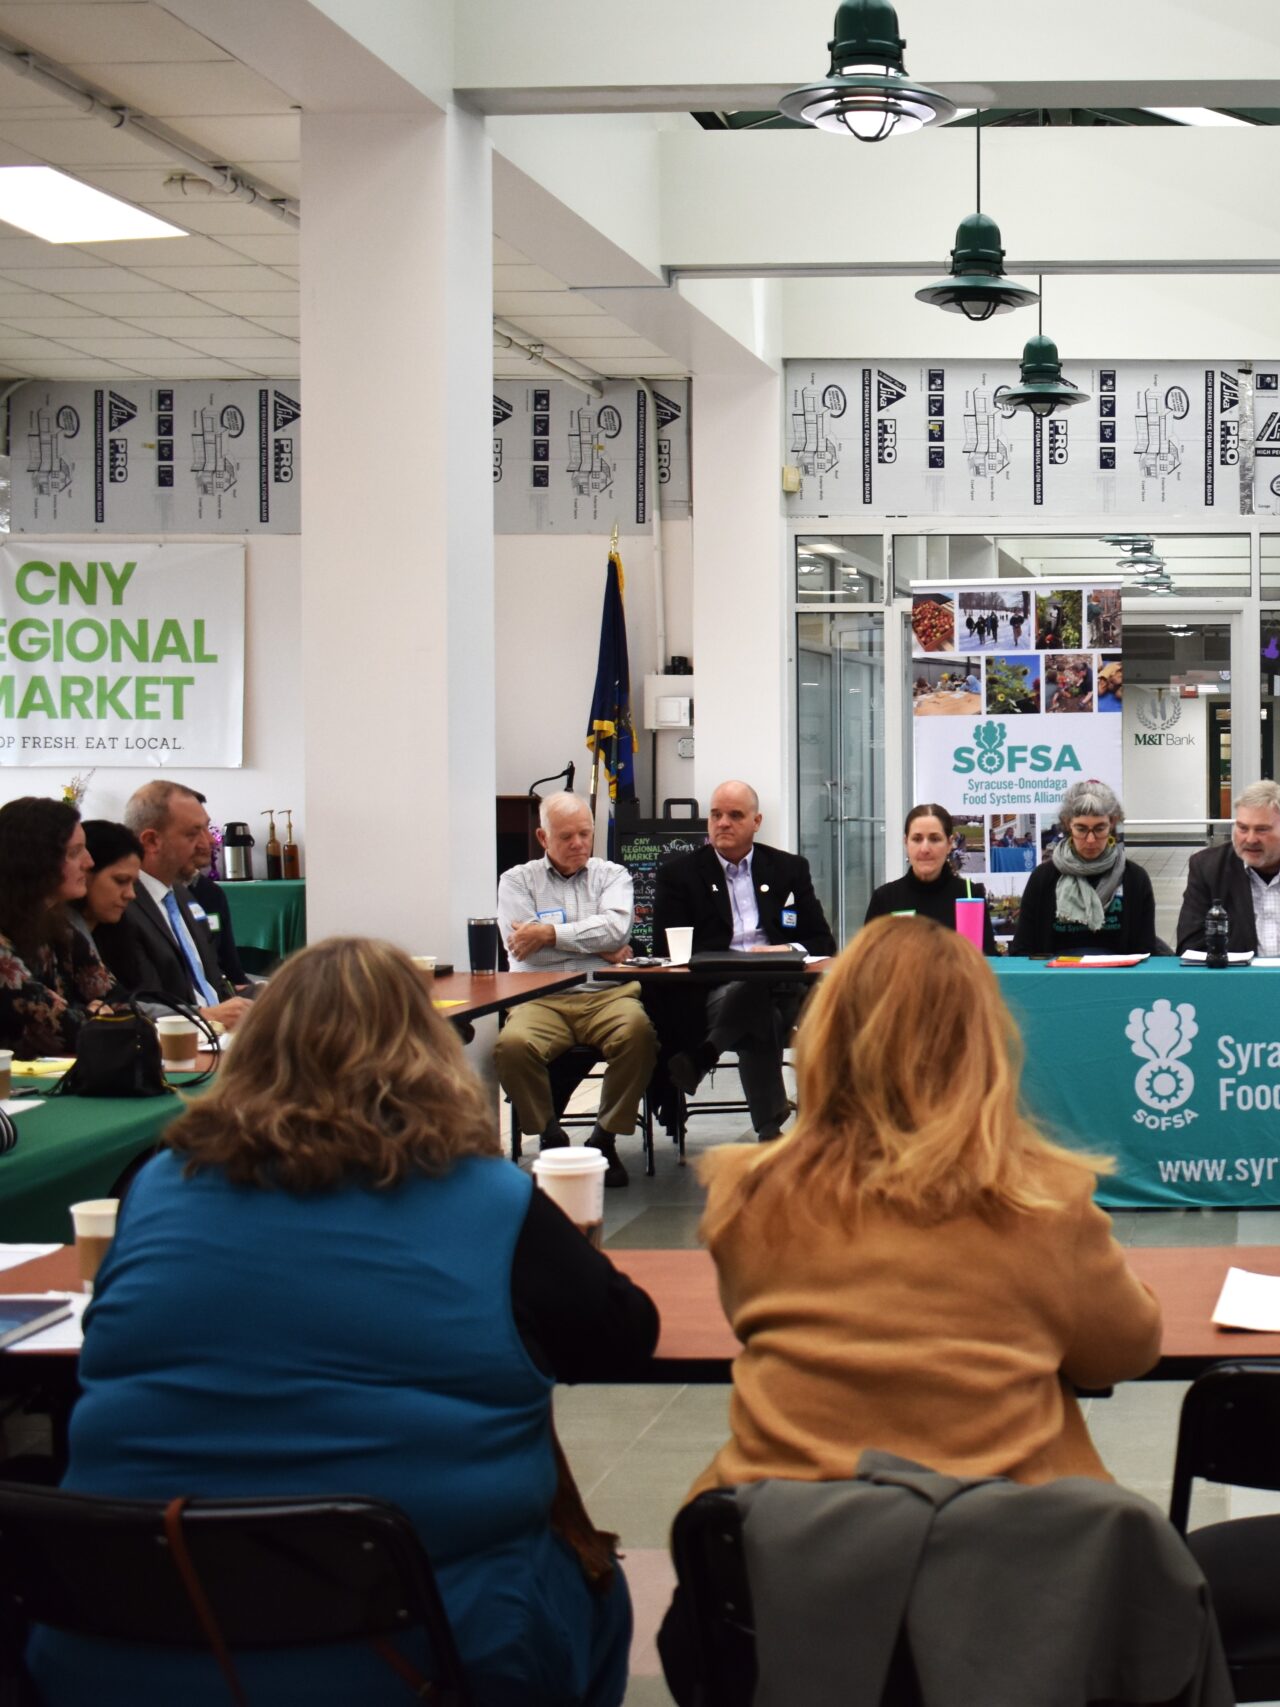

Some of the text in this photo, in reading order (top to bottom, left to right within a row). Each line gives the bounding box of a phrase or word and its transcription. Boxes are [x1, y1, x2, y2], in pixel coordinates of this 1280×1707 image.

[880, 383, 897, 407] Sika
[1223, 385, 1239, 408] Sika
[111, 404, 128, 427] Sika
[276, 404, 293, 427] Sika
[883, 419, 897, 463] PRO
[1055, 420, 1068, 465] PRO
[1226, 420, 1239, 465] PRO
[115, 439, 128, 482] PRO
[280, 439, 293, 482] PRO
[658, 440, 671, 484] PRO
[15, 560, 138, 606] CNY
[0, 618, 218, 664] GIONAL
[21, 736, 79, 750] FRESH.
[86, 736, 119, 750] EAT
[125, 736, 185, 751] LOCAL.
[1134, 733, 1196, 746] M&T Bank
[953, 744, 1082, 775] SOFSA
[967, 777, 1068, 791] Syracuse-Onondaga
[963, 793, 988, 805] Food
[989, 792, 1031, 807] Systems
[621, 845, 662, 853] REGIONAL
[623, 852, 660, 861] MARKET
[1132, 1107, 1199, 1131] SOFSA
